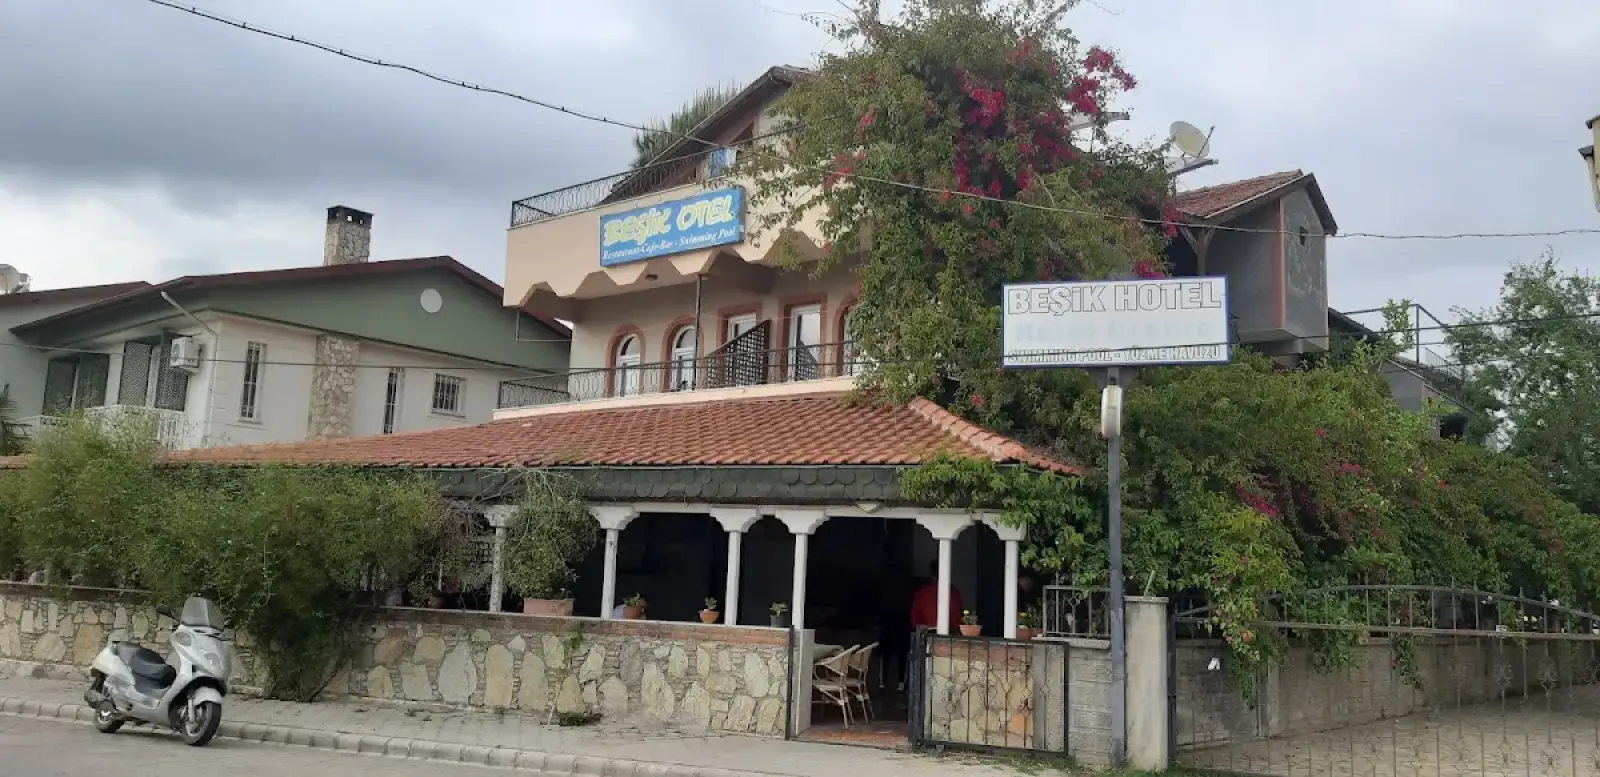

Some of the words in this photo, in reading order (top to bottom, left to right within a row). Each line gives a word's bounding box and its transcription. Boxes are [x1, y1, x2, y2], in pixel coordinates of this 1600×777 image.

[676, 195, 735, 231] OTEL
[680, 231, 717, 244] Swimming
[718, 227, 737, 239] Pool
[1114, 281, 1222, 311] HOTEL
[1006, 349, 1076, 363] SWIMMING
[1079, 348, 1112, 362] POOL
[1124, 345, 1168, 361] YÜZME
[1169, 345, 1220, 360] HAVUZU
